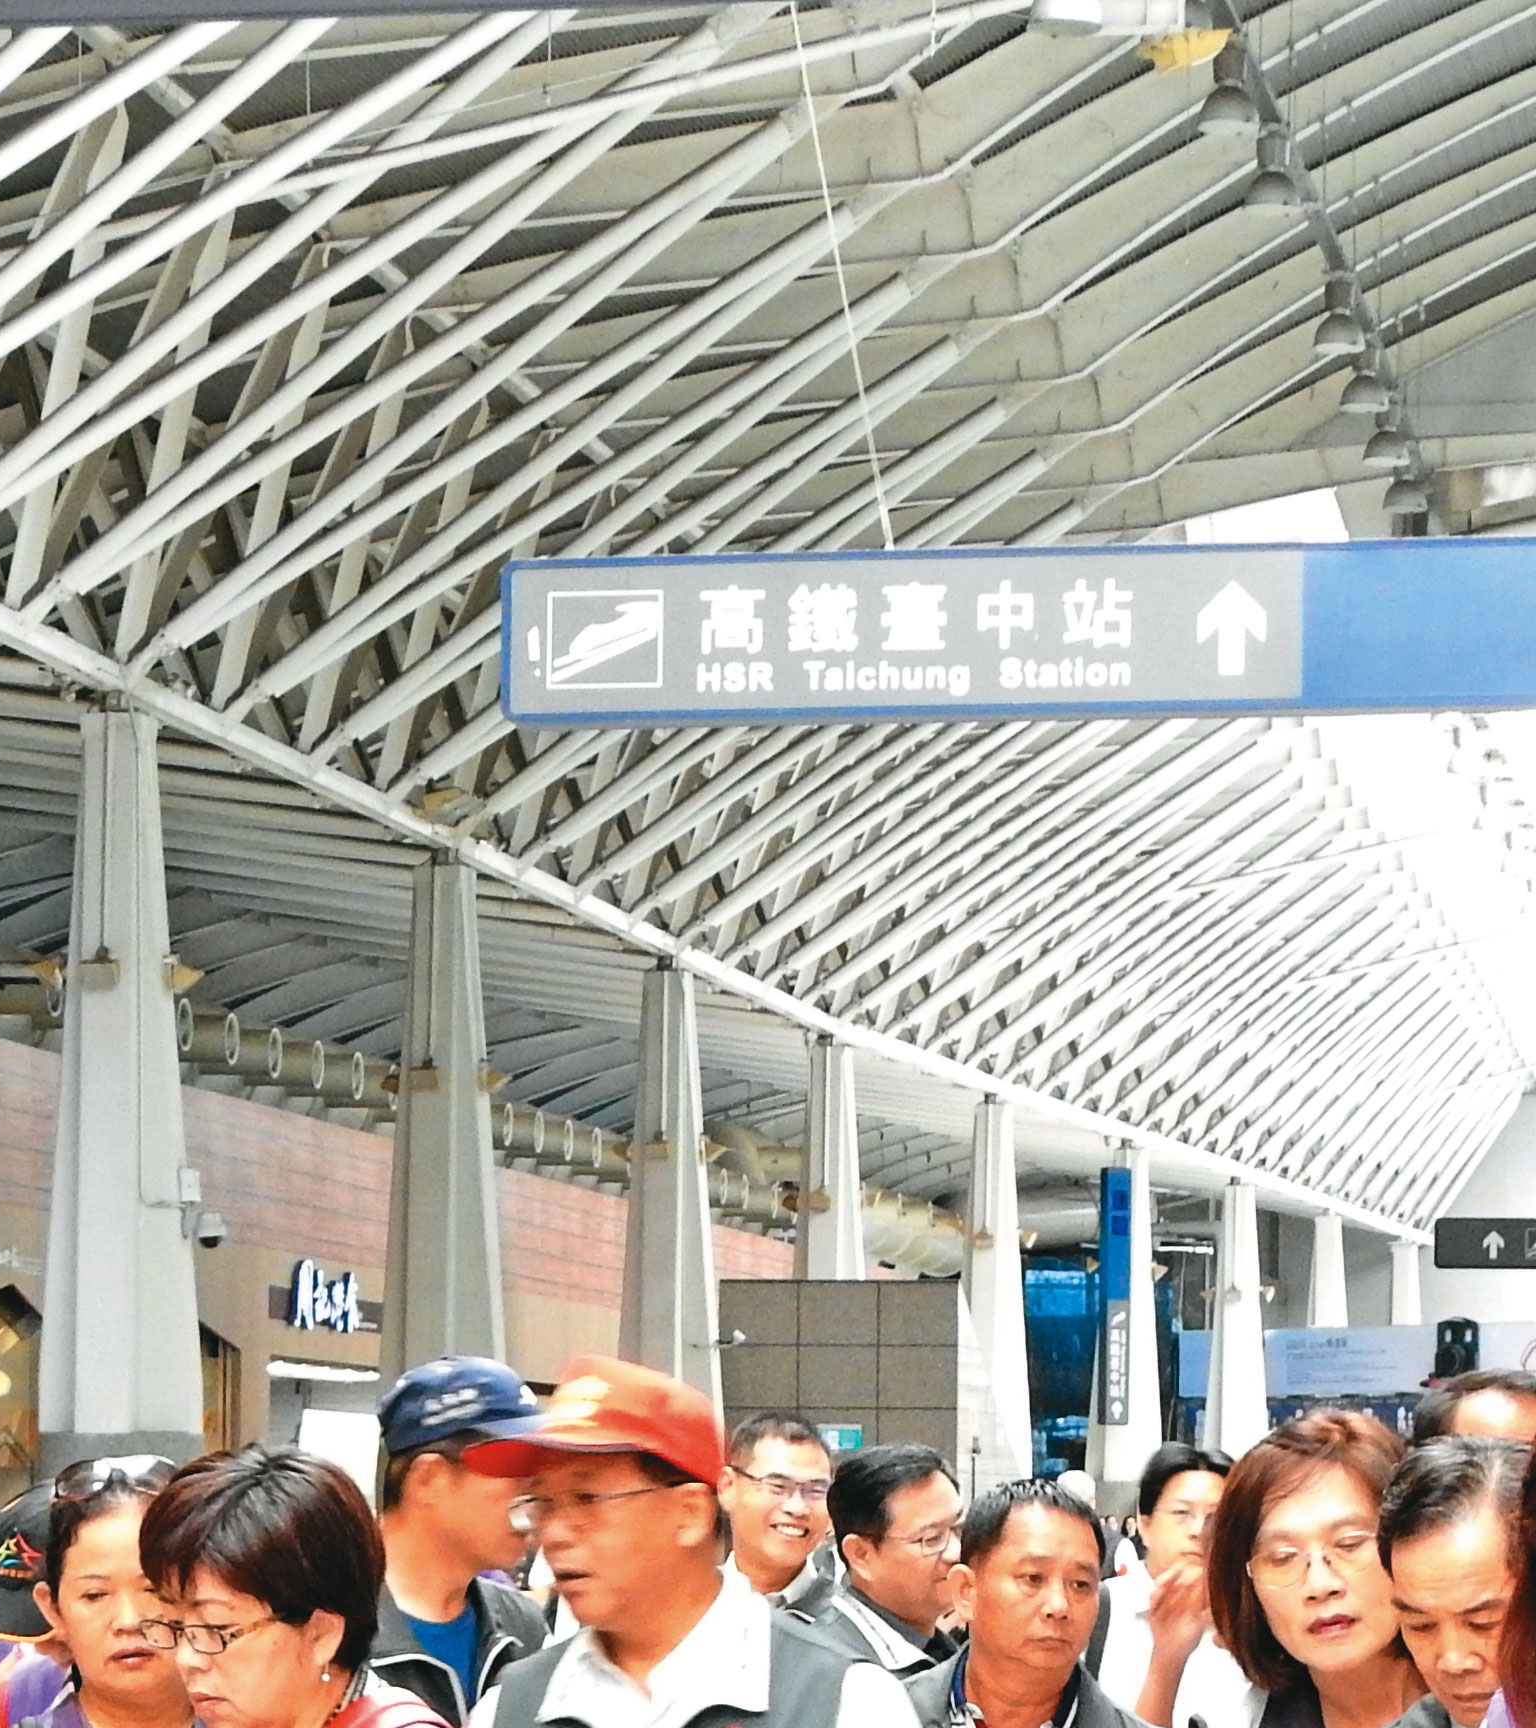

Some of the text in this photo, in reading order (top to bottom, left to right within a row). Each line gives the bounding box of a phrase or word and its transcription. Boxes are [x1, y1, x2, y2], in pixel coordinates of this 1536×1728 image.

[699, 577, 1134, 655] 高鐵臺中站
[696, 656, 1132, 697] HSR Taichung Station
